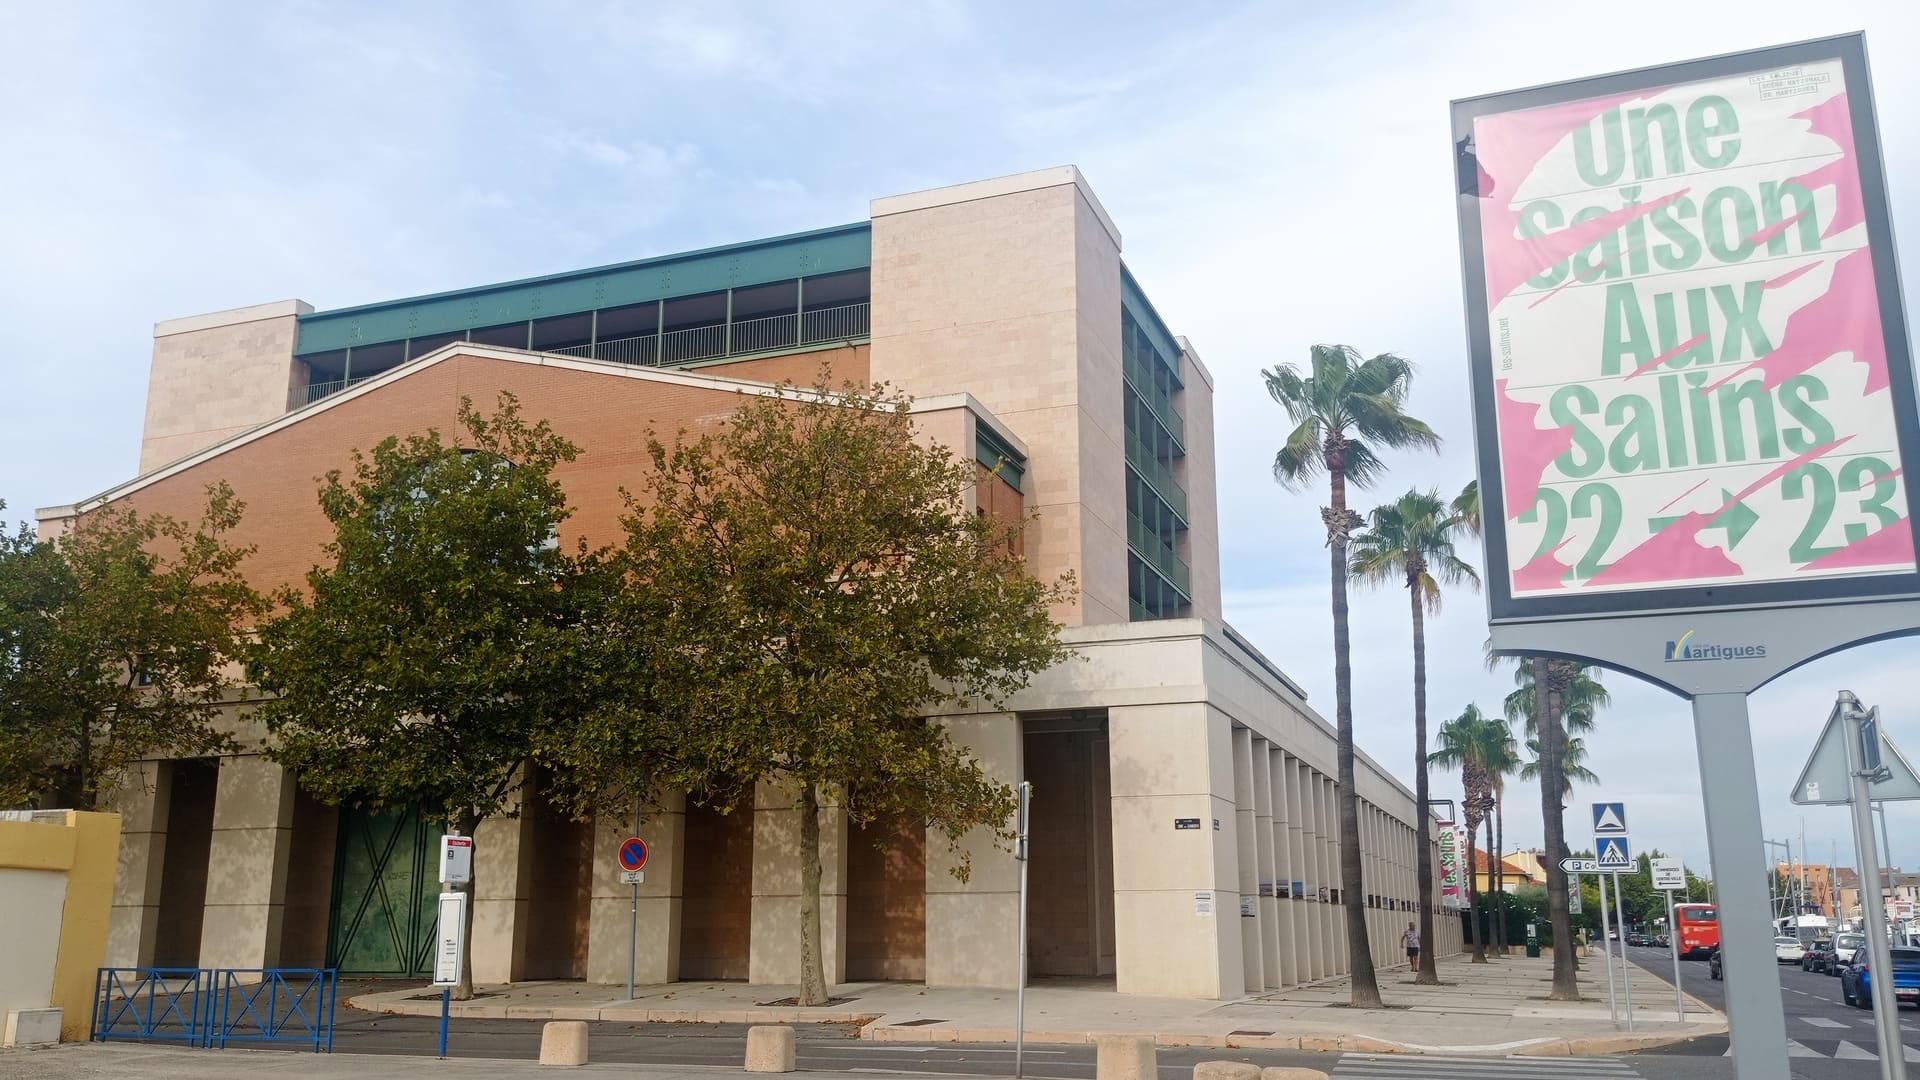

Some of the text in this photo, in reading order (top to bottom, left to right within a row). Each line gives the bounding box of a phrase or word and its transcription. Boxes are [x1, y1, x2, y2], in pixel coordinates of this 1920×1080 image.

[1573, 95, 1742, 187] Une
[1516, 180, 1821, 290] Saison
[1601, 280, 1773, 377] Aux
[1549, 370, 1836, 479] Salins
[1518, 456, 1902, 581] 22 23
[1664, 640, 1767, 661] Martigues
